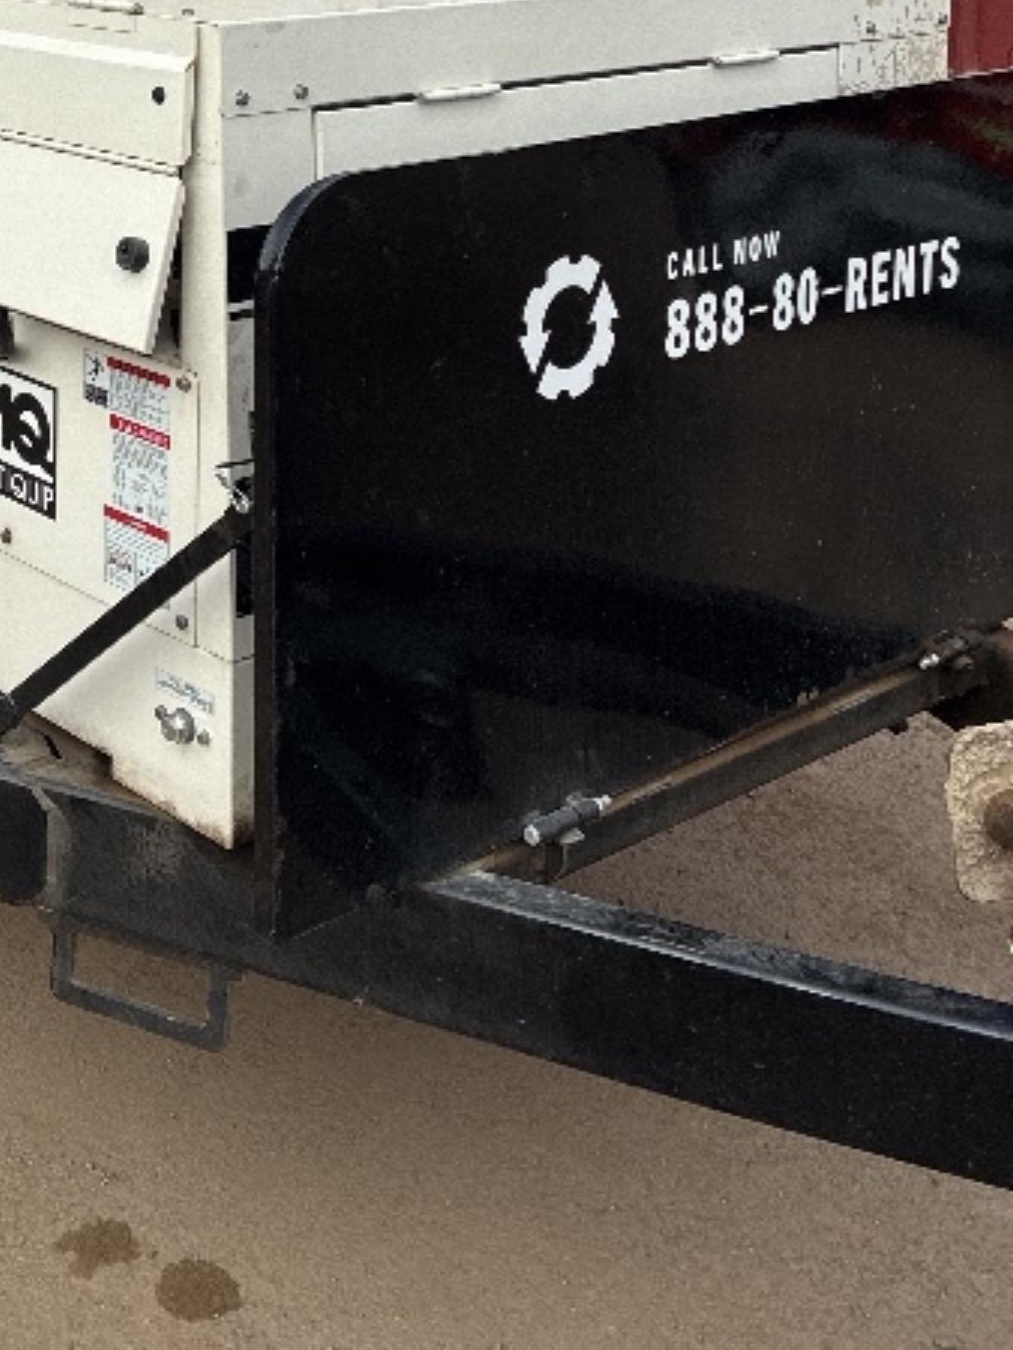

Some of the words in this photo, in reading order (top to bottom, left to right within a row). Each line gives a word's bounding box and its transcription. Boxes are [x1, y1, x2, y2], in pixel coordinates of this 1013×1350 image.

[664, 236, 961, 359] 888-80-RENTS
[666, 243, 723, 281] CALL
[732, 229, 781, 265] NOW
